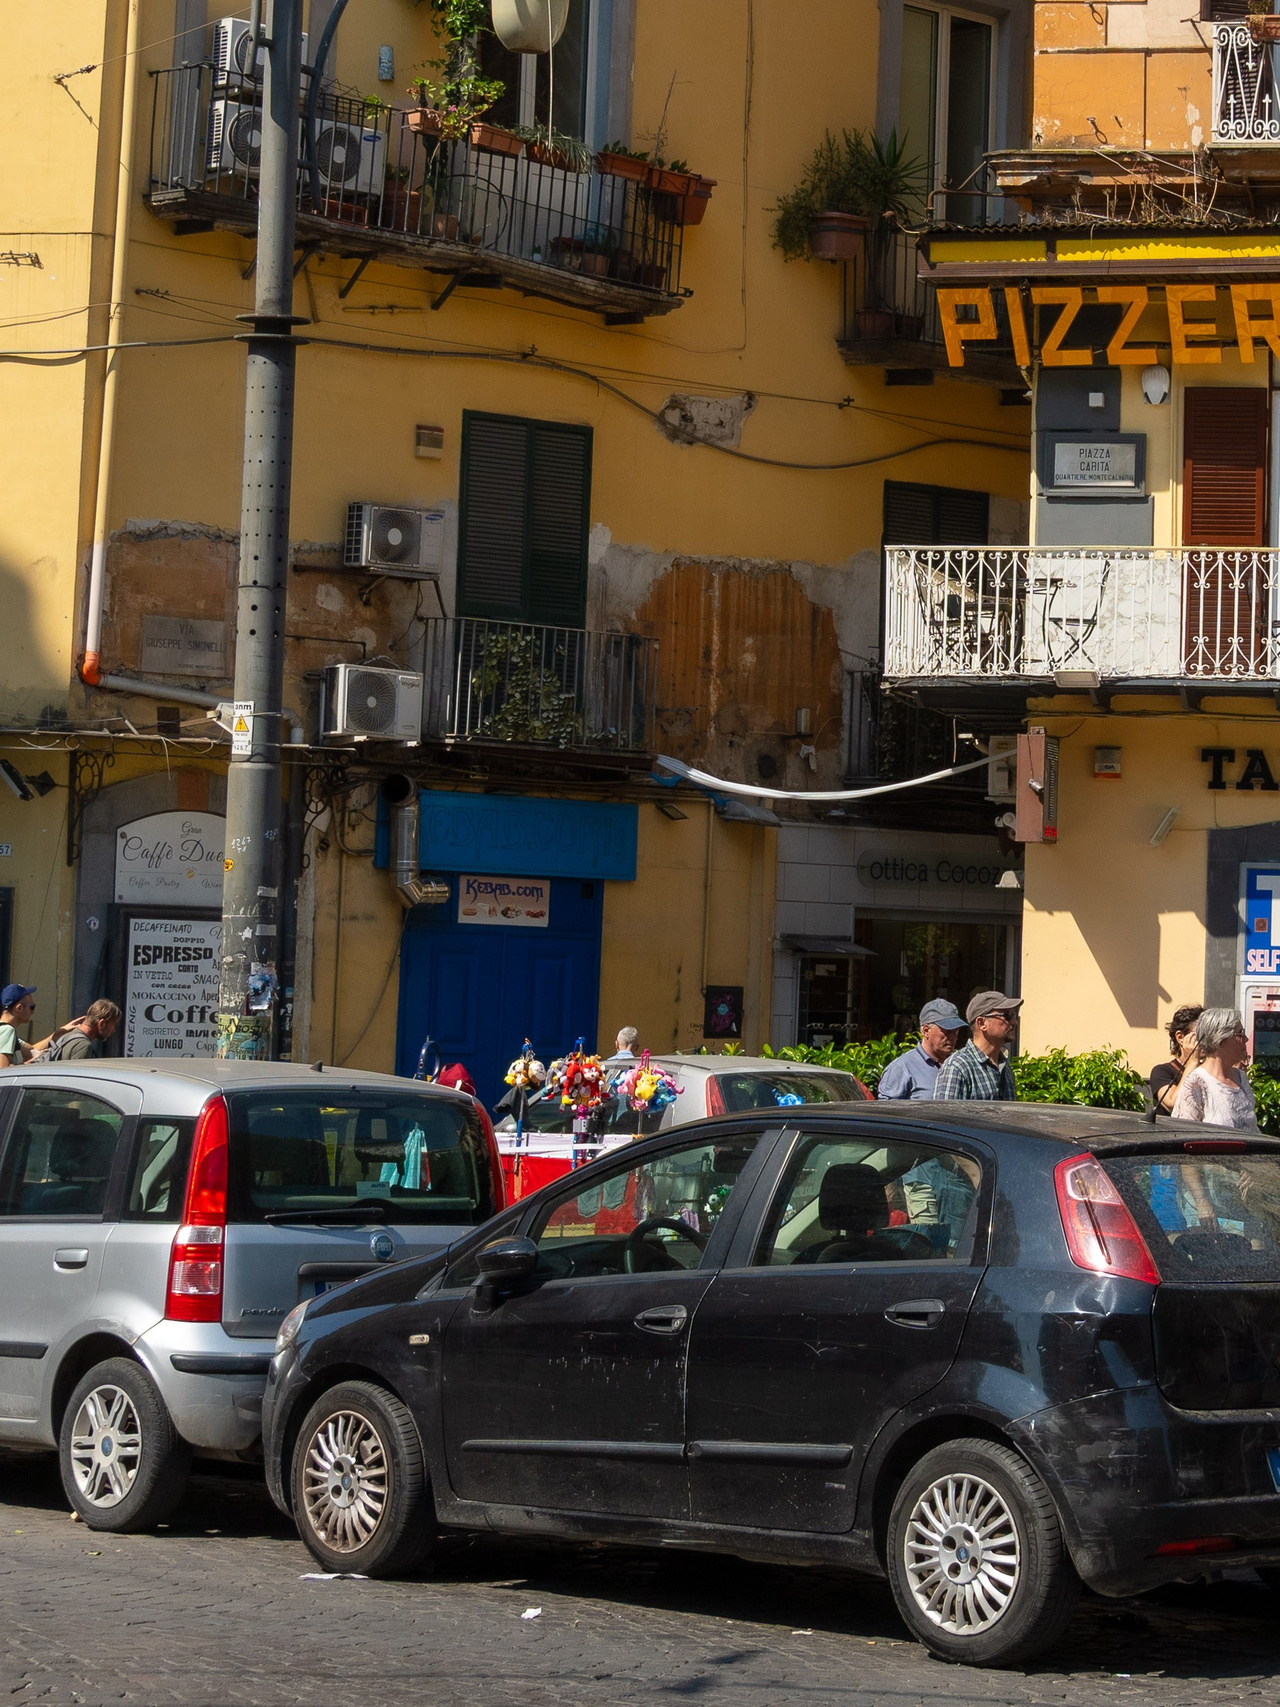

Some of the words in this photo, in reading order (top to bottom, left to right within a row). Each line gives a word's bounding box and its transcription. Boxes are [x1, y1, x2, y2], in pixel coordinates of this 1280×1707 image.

[1079, 448, 1111, 459] PIAZZA
[179, 623, 194, 635] VIA
[122, 836, 174, 869] Caffè
[869, 857, 929, 883] ottica
[133, 922, 192, 934] DECAFFEINATO
[173, 936, 205, 944] DOPPIO
[133, 944, 213, 966] ESPRESSO
[1247, 949, 1280, 973] SELF
[178, 964, 199, 974] CORTO
[134, 971, 143, 979] IN
[145, 971, 173, 980] VETRO
[132, 991, 196, 1001] MOKACCINO
[142, 1027, 181, 1036] RISTRETTO
[185, 1029, 209, 1038] IRISH
[154, 1039, 183, 1050] LUNGO
[376, 1242, 392, 1252] FIAT
